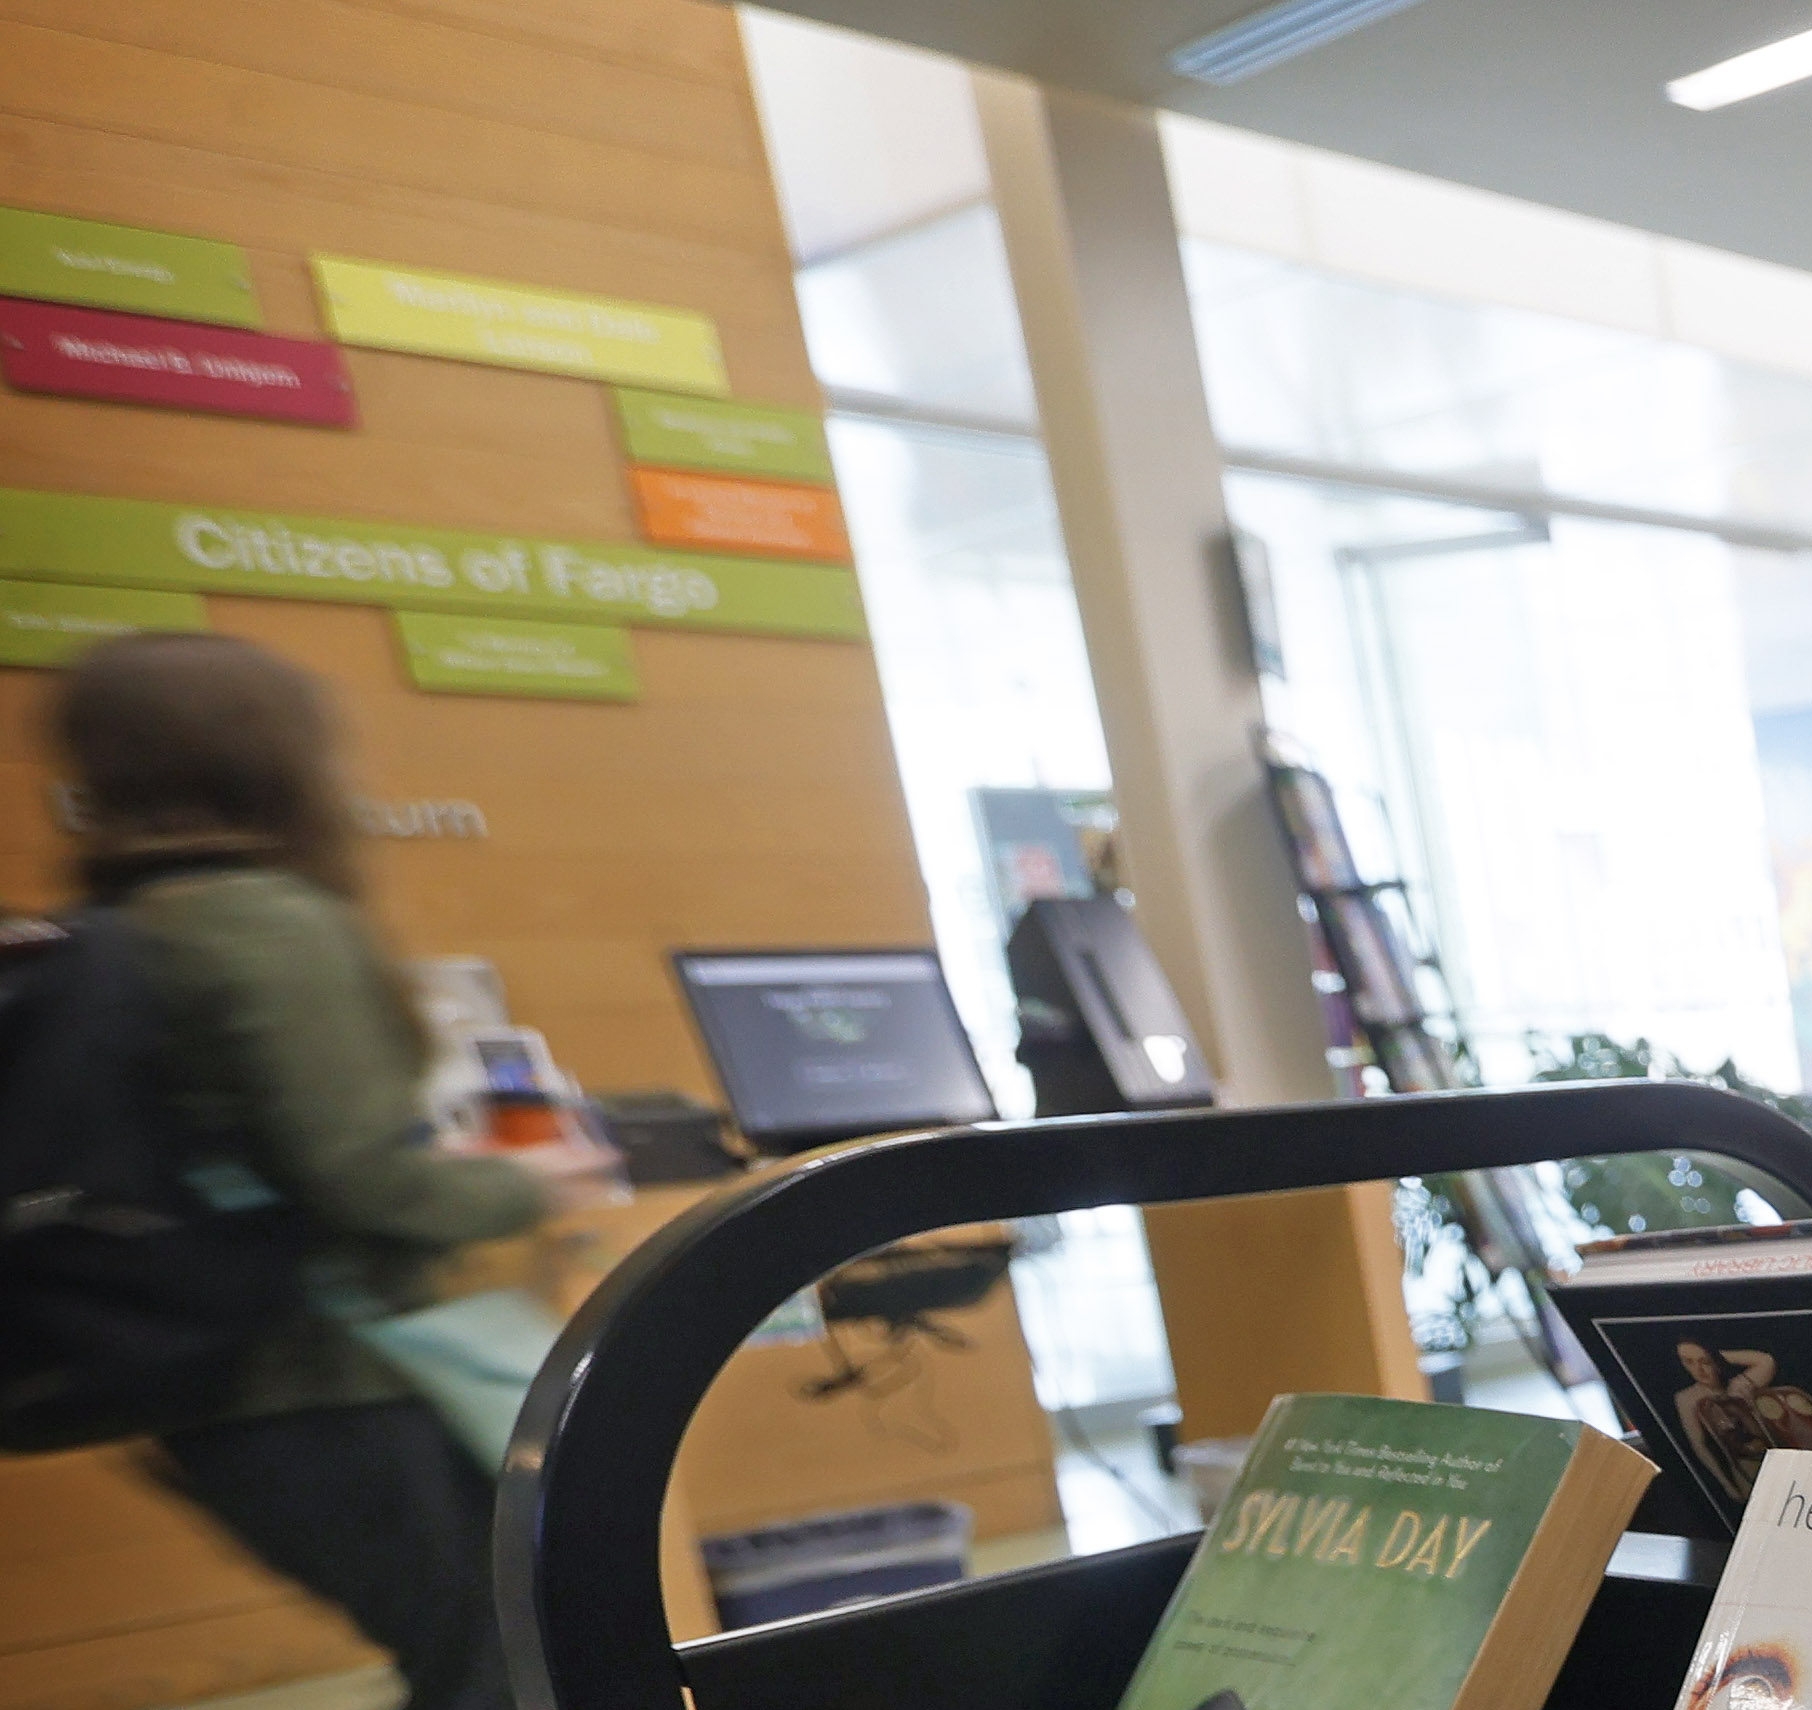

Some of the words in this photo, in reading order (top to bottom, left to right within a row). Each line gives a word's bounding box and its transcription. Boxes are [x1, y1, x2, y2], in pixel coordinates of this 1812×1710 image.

[174, 516, 450, 587] Citizens
[467, 541, 530, 594] of
[545, 547, 720, 618] Fargo
[1221, 1489, 1371, 1565] SYLVIA
[1375, 1508, 1493, 1579] DAY
